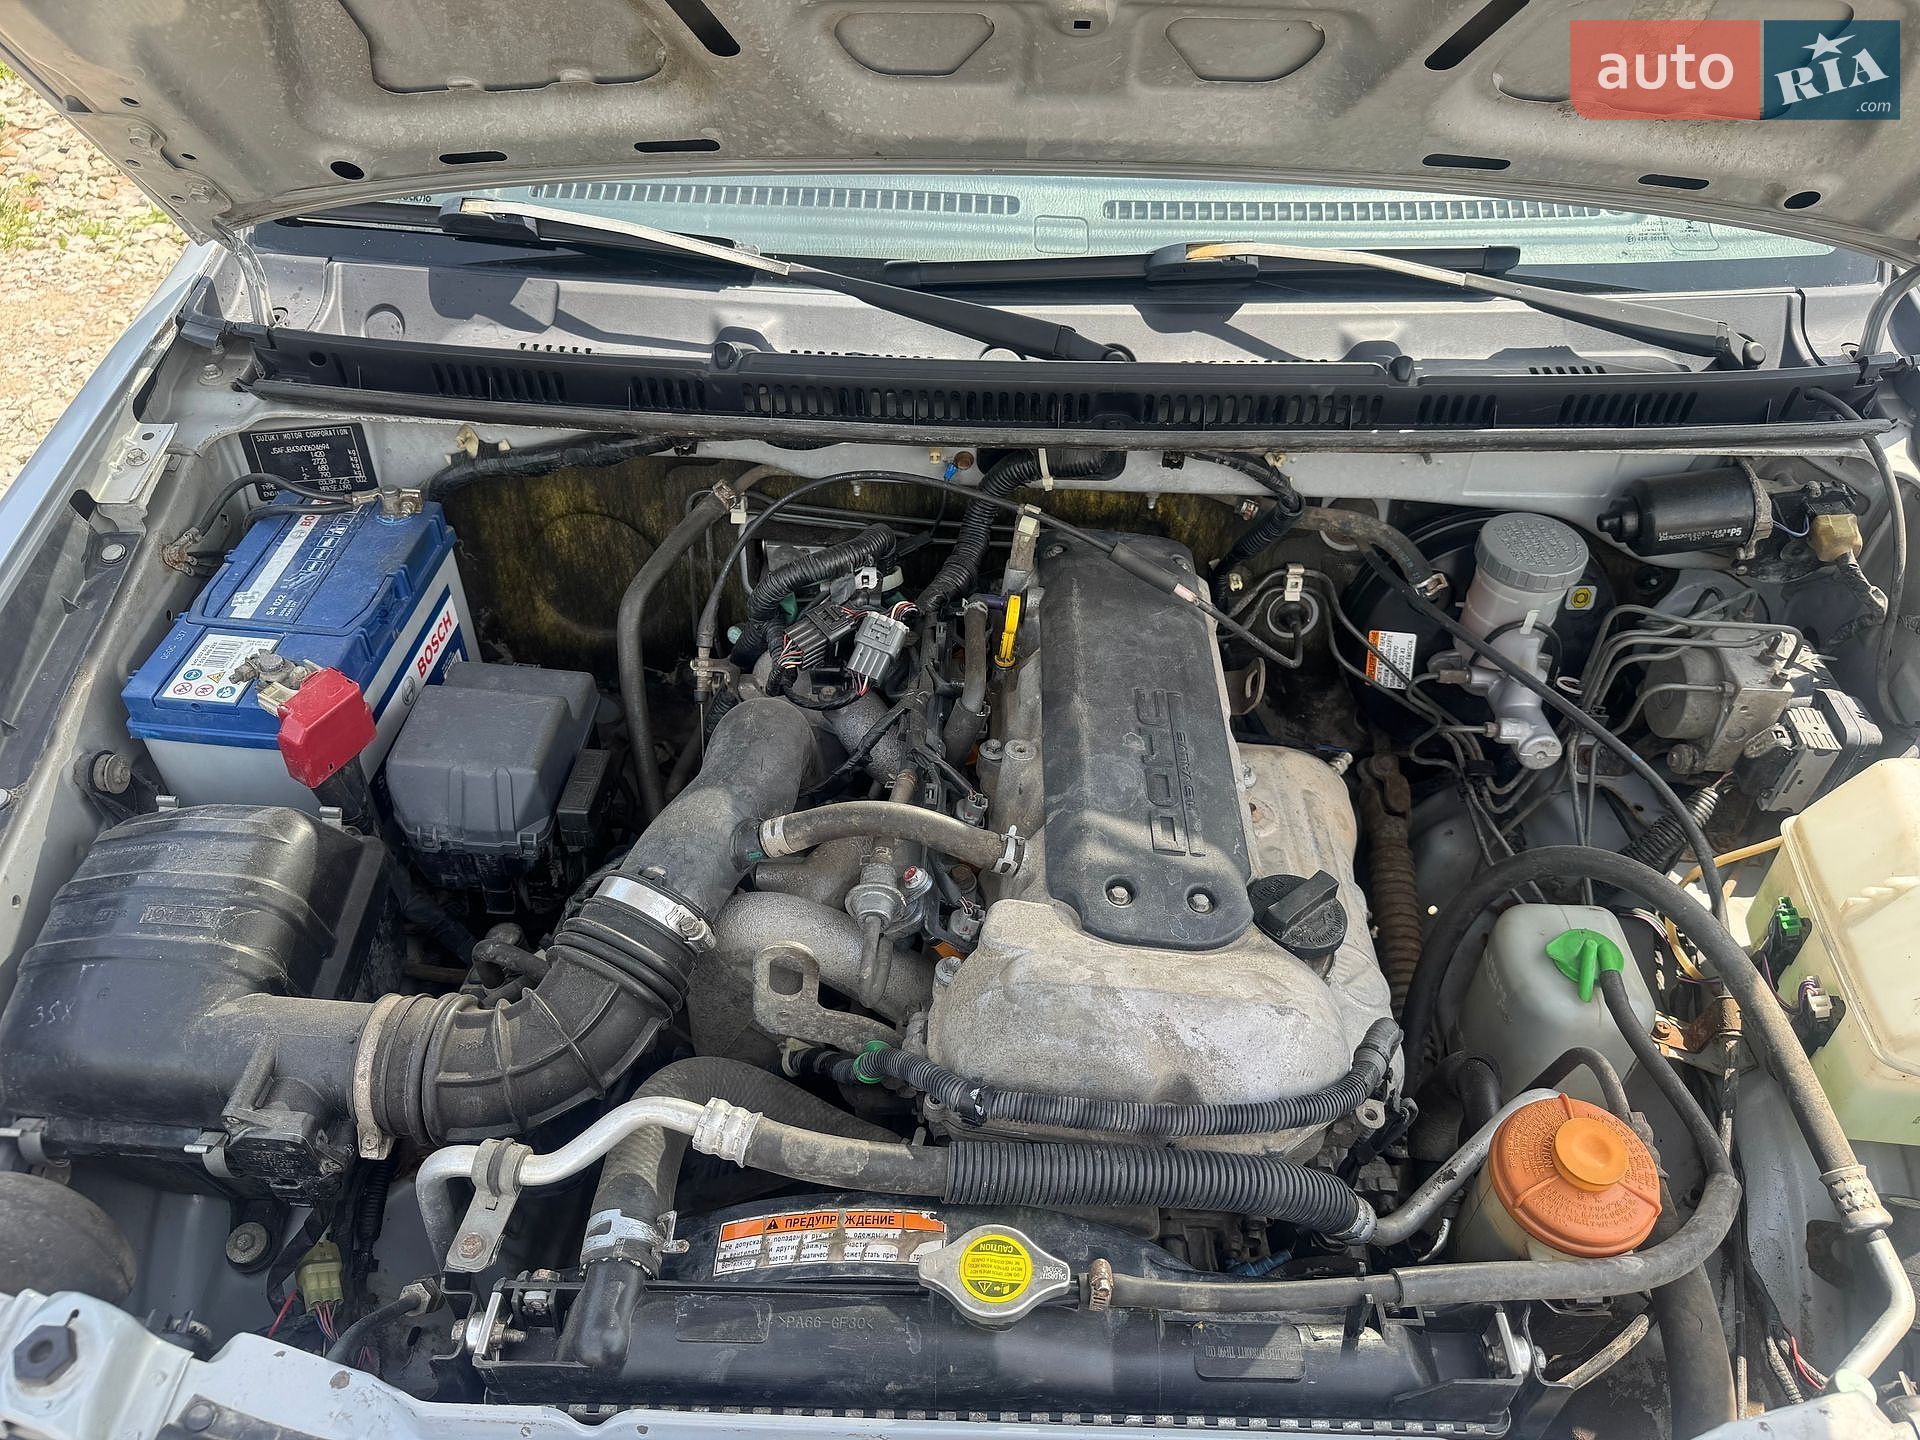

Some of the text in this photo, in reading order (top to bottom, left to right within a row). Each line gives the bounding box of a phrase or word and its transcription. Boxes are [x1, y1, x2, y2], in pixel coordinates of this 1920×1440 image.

[256, 428, 348, 443] SUZUKI MOTOR CORPORATION
[416, 610, 453, 678] BOSCH
[785, 1214, 895, 1229] ПРЕДУПРЖДЕНИЕ
[979, 1243, 1013, 1253] CAUTION
